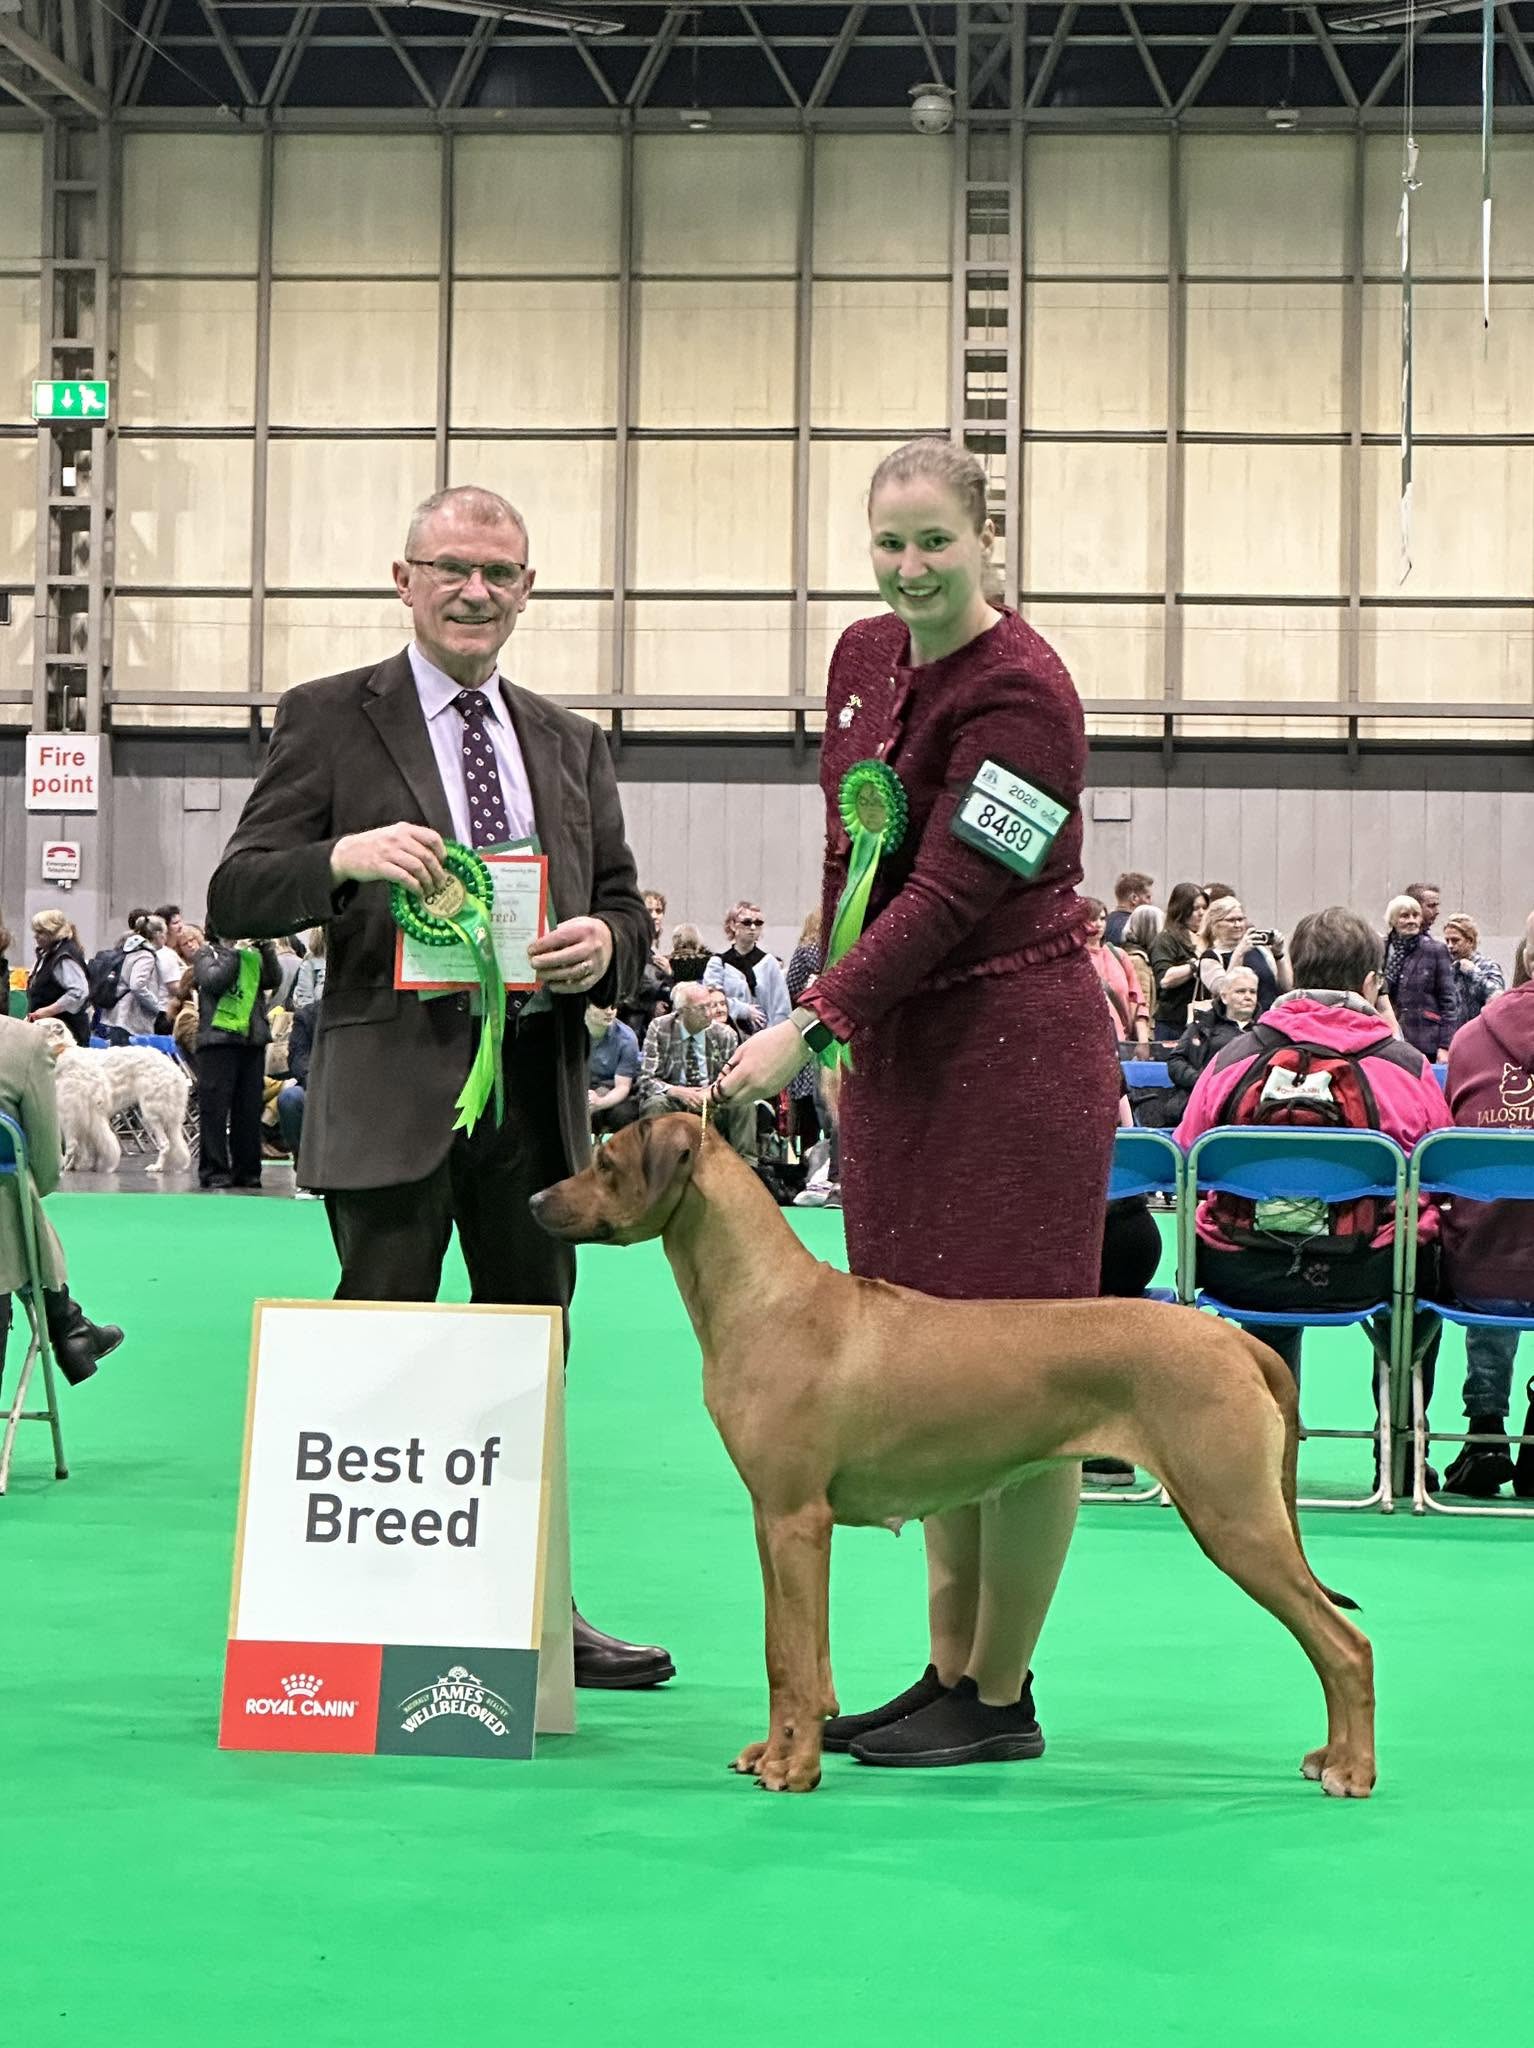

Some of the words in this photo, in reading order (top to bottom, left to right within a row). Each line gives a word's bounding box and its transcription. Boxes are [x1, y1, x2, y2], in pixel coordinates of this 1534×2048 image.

[40, 746, 85, 766] Fire
[32, 774, 93, 797] point
[1008, 785, 1039, 809] 2026
[977, 804, 1033, 852] 8489
[488, 909, 517, 923] reed
[296, 1431, 425, 1484] Best
[445, 1436, 501, 1486] of
[305, 1493, 479, 1547] Breed
[431, 1685, 485, 1704] JAMES
[245, 1698, 297, 1715] ROYAL
[300, 1699, 355, 1717] CANIN
[400, 1699, 506, 1736] WELLBELOVED
